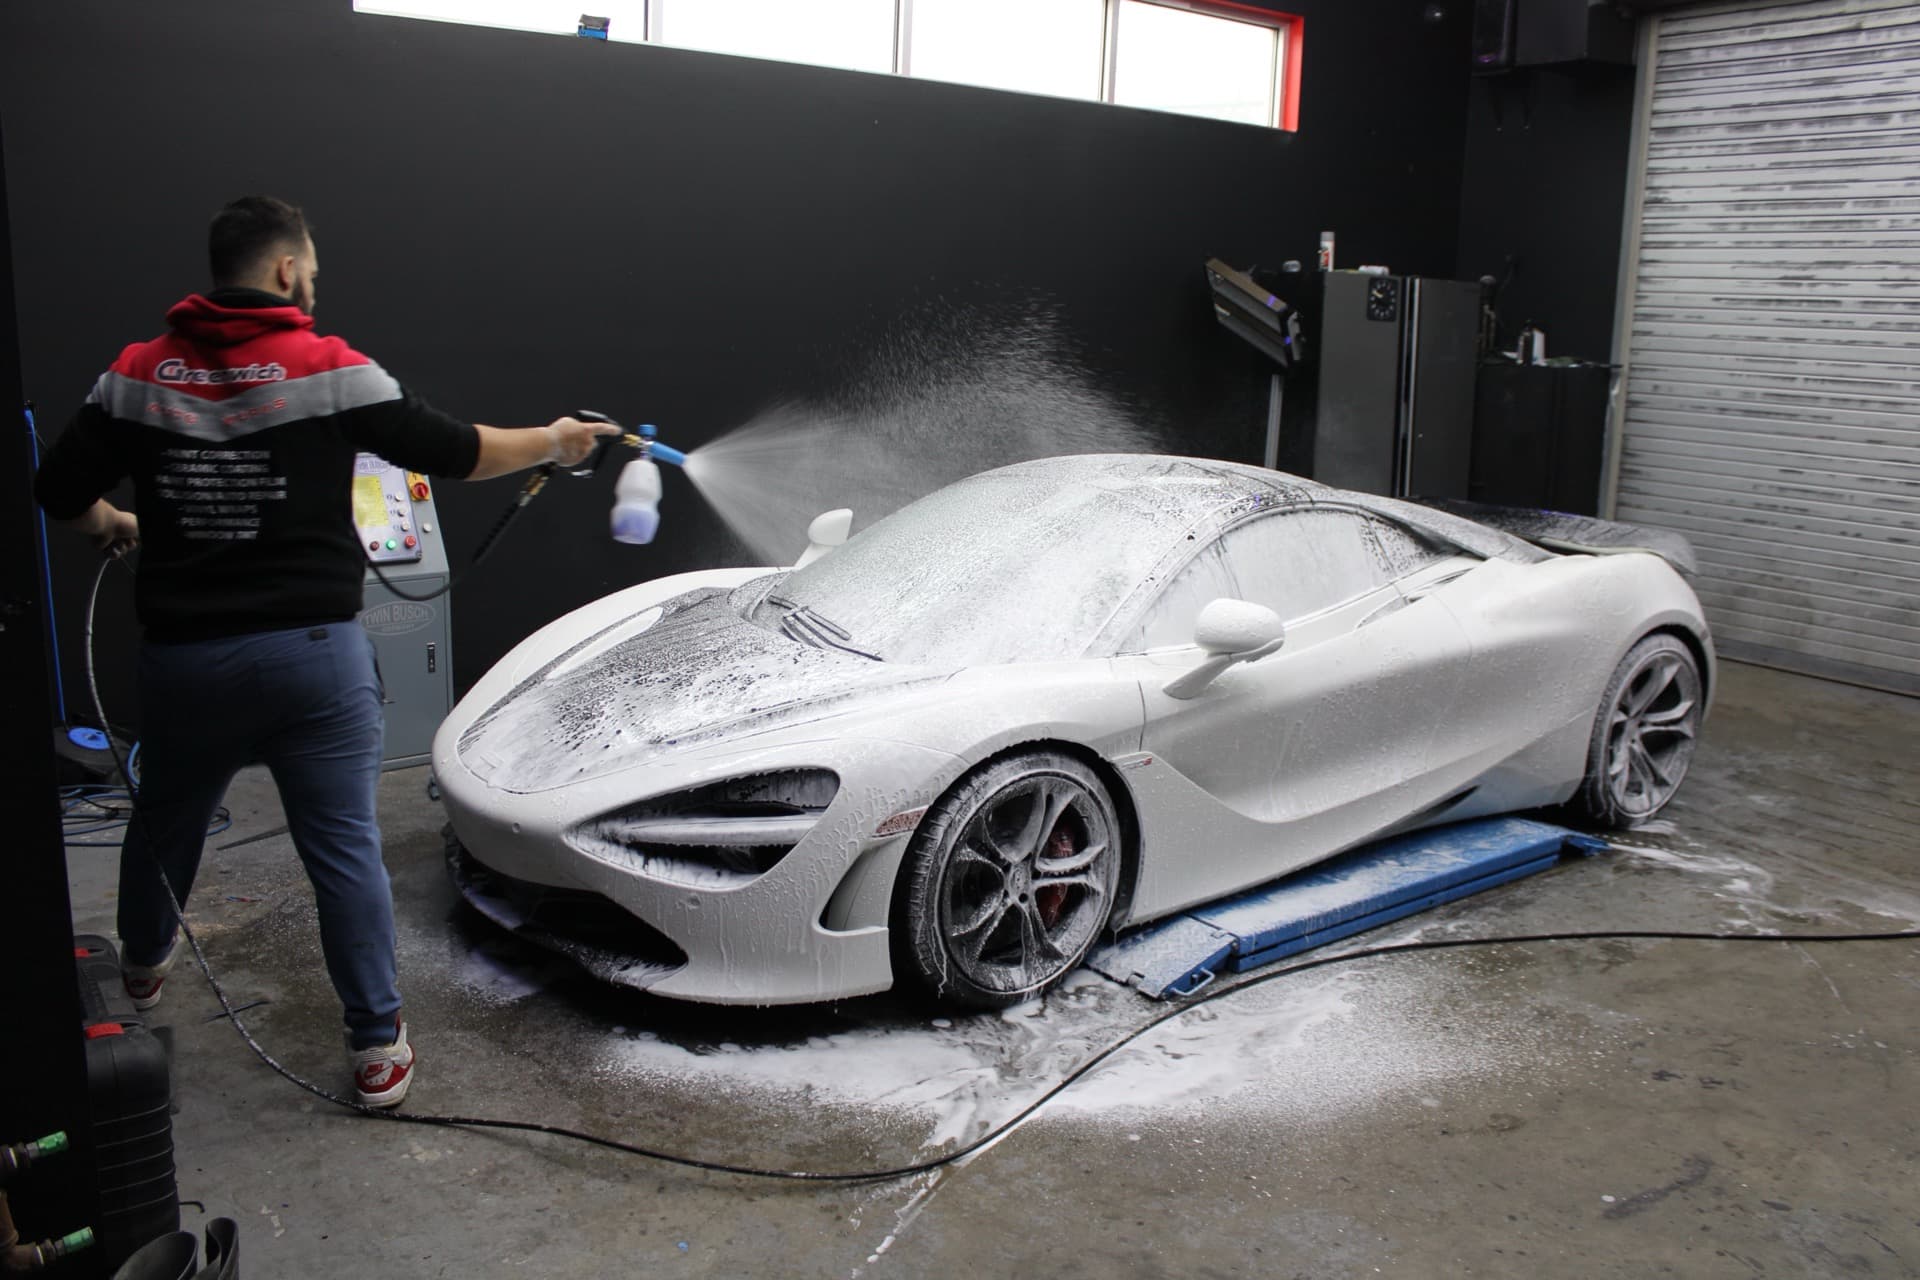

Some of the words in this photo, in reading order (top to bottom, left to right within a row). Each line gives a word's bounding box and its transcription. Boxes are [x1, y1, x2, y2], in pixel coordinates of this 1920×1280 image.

[154, 358, 287, 384] Greenwich
[366, 606, 391, 625] TWIN
[392, 602, 429, 623] BUSCH
